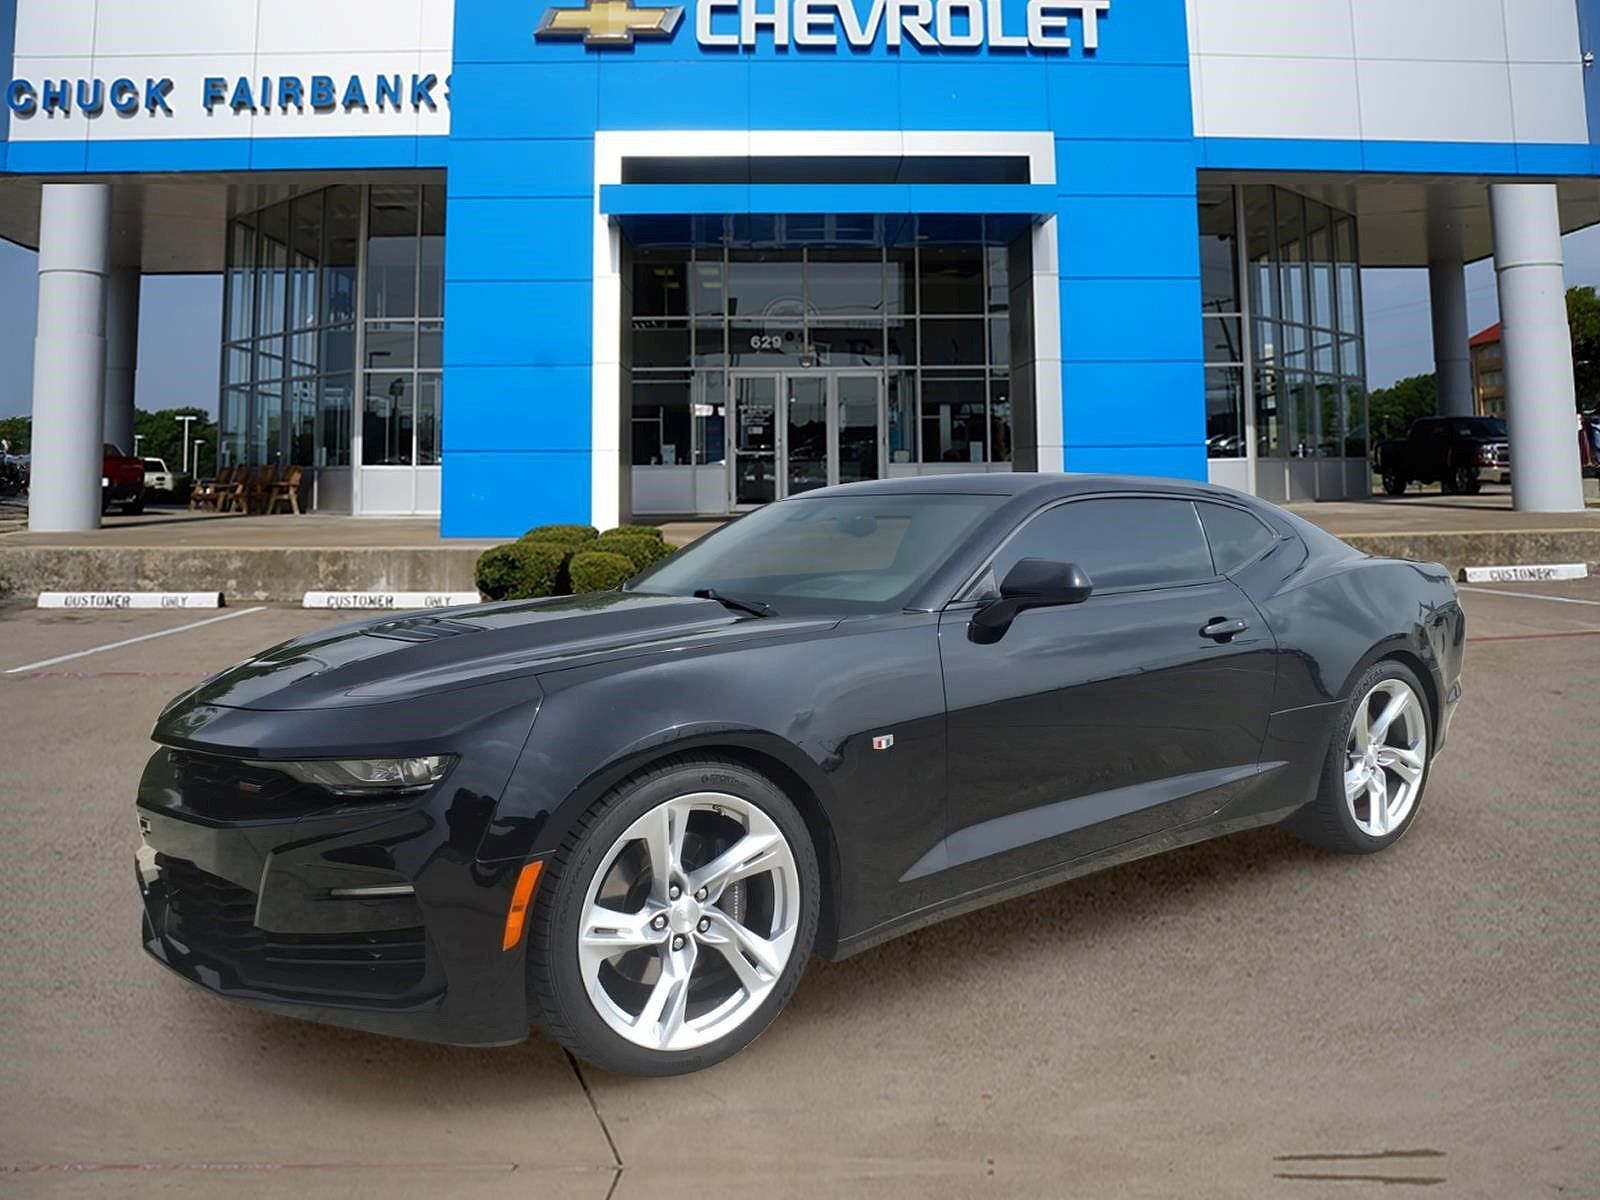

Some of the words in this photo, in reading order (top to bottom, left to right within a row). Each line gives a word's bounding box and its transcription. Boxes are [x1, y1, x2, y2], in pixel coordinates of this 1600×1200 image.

[696, 0, 1109, 49] CHEVROLET
[7, 78, 173, 117] CHUCK
[203, 74, 452, 114] FAIRBANK
[750, 335, 782, 349] 629
[1489, 567, 1556, 580] CUSTOMER
[64, 595, 131, 608] CUSTOMER
[326, 595, 394, 608] CUSTOMER
[424, 595, 452, 607] ONLY
